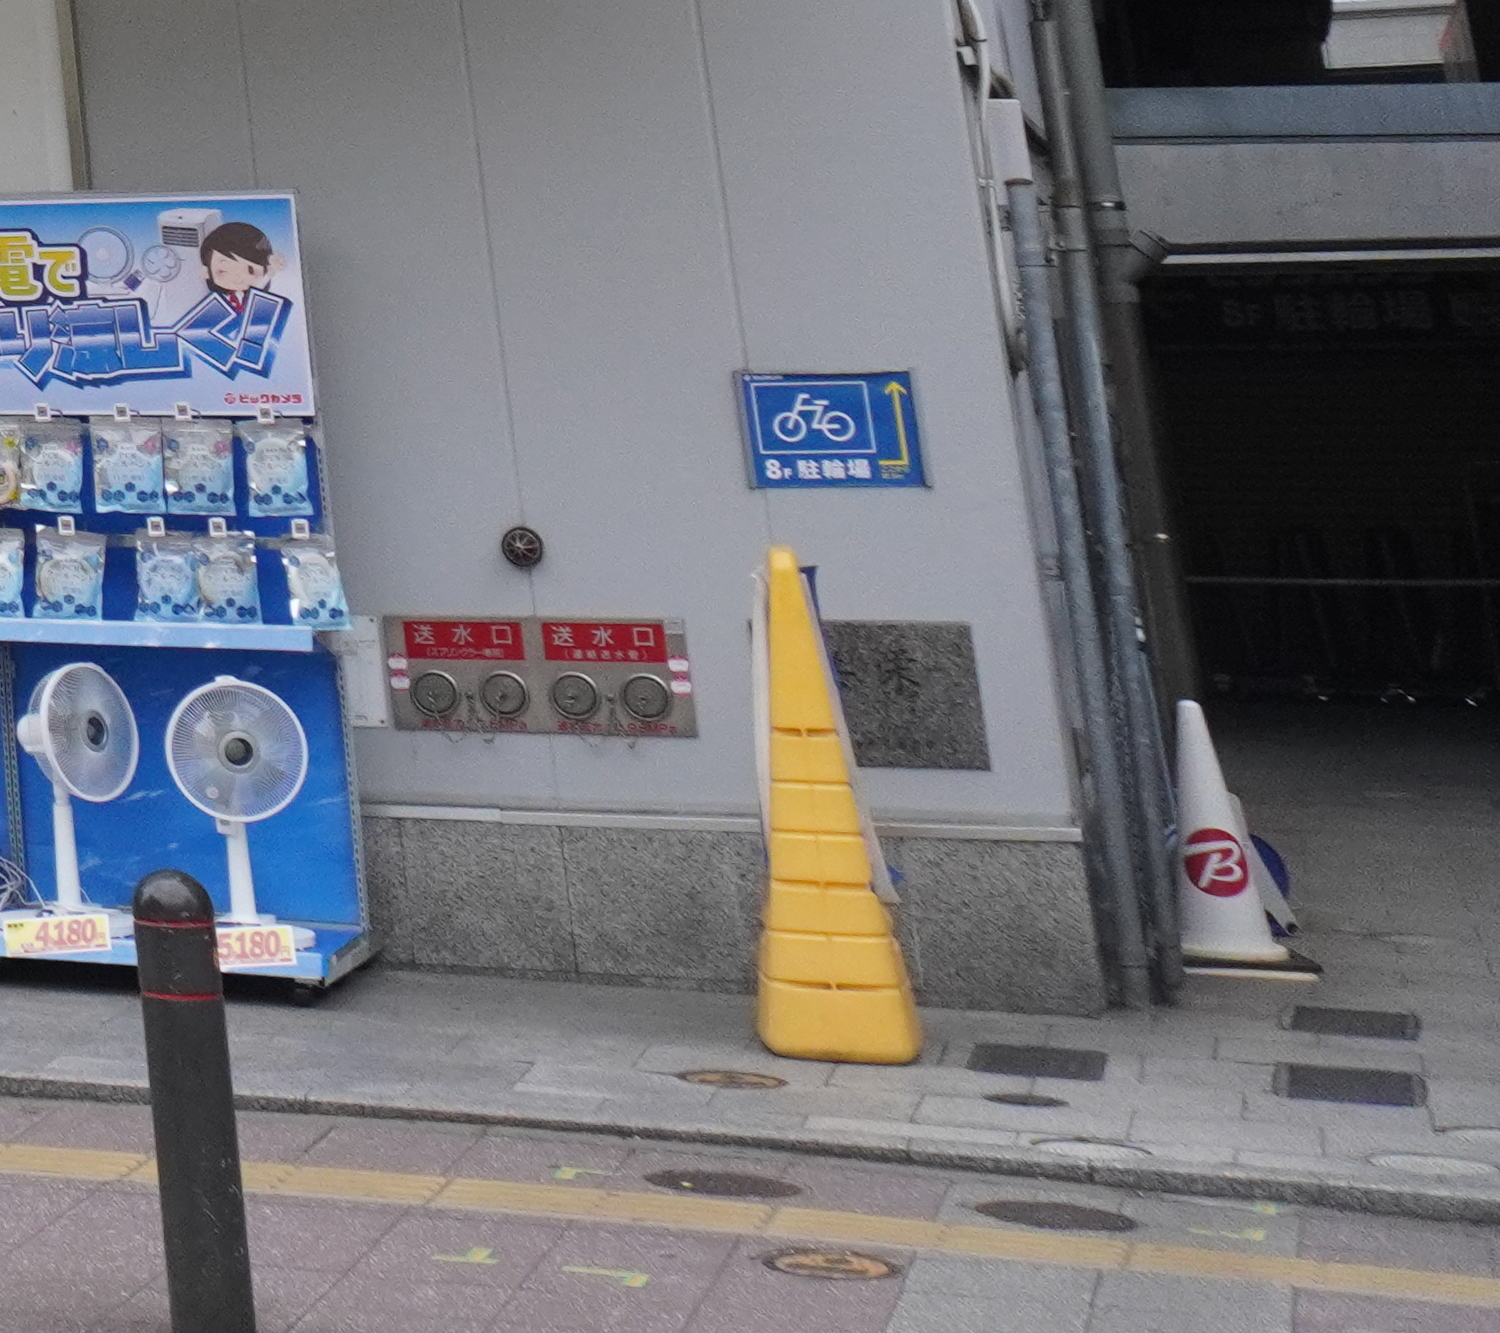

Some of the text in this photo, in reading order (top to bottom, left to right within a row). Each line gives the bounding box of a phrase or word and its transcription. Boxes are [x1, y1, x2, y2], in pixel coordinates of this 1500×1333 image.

[796, 459, 871, 479] 駐輪場
[414, 625, 512, 645] 送水口
[551, 626, 654, 647] 送水口
